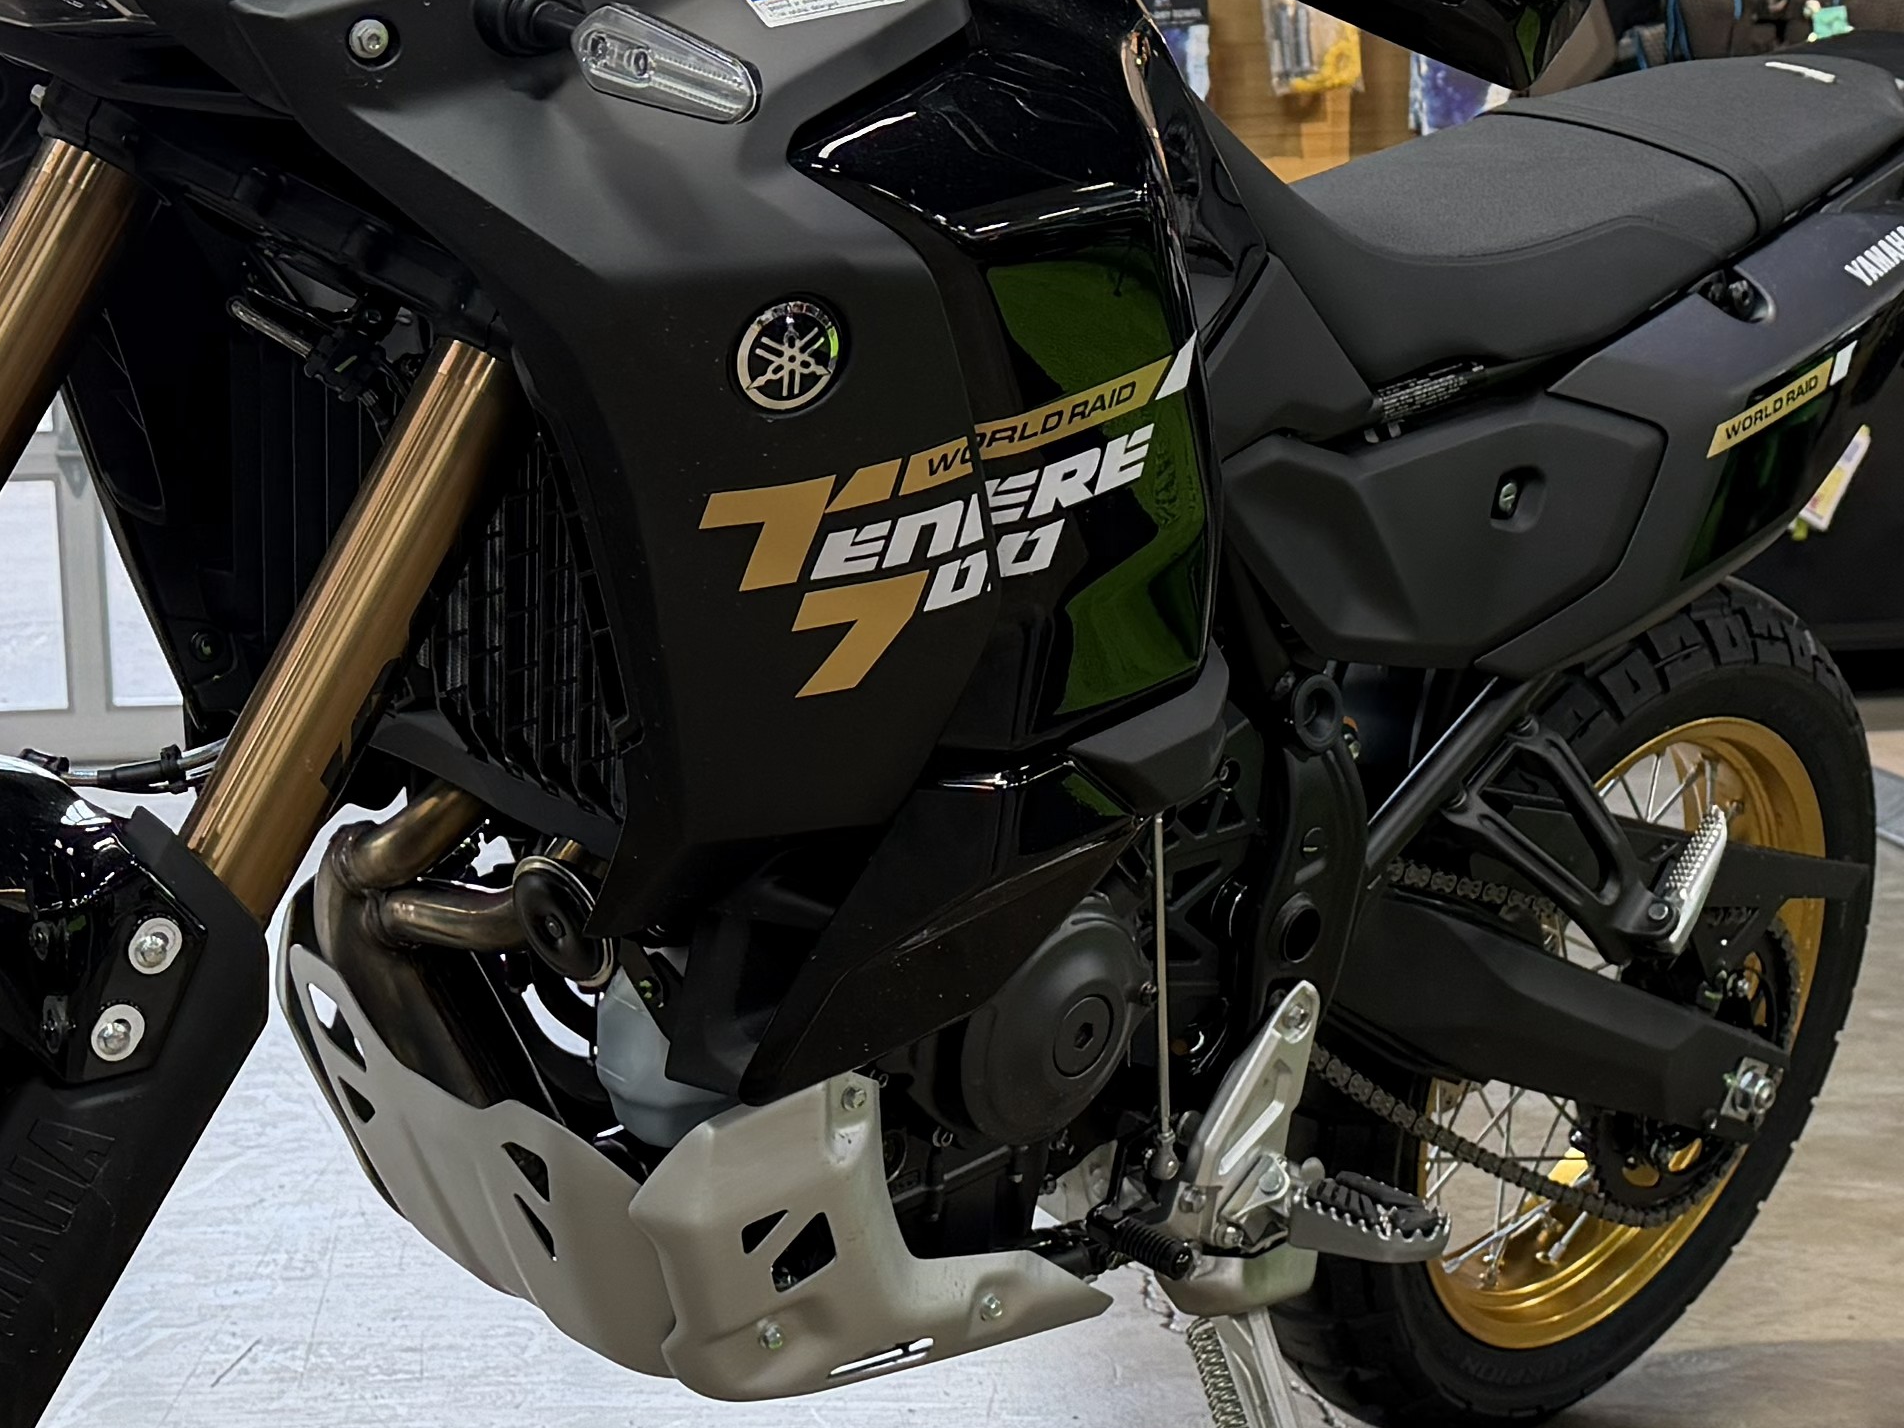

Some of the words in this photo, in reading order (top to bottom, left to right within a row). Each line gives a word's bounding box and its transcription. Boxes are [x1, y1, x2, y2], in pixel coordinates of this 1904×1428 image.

[927, 409, 1063, 477] WORLD
[1067, 380, 1137, 425] RAID
[1725, 396, 1784, 441] WORLD
[1786, 374, 1819, 407] RAID
